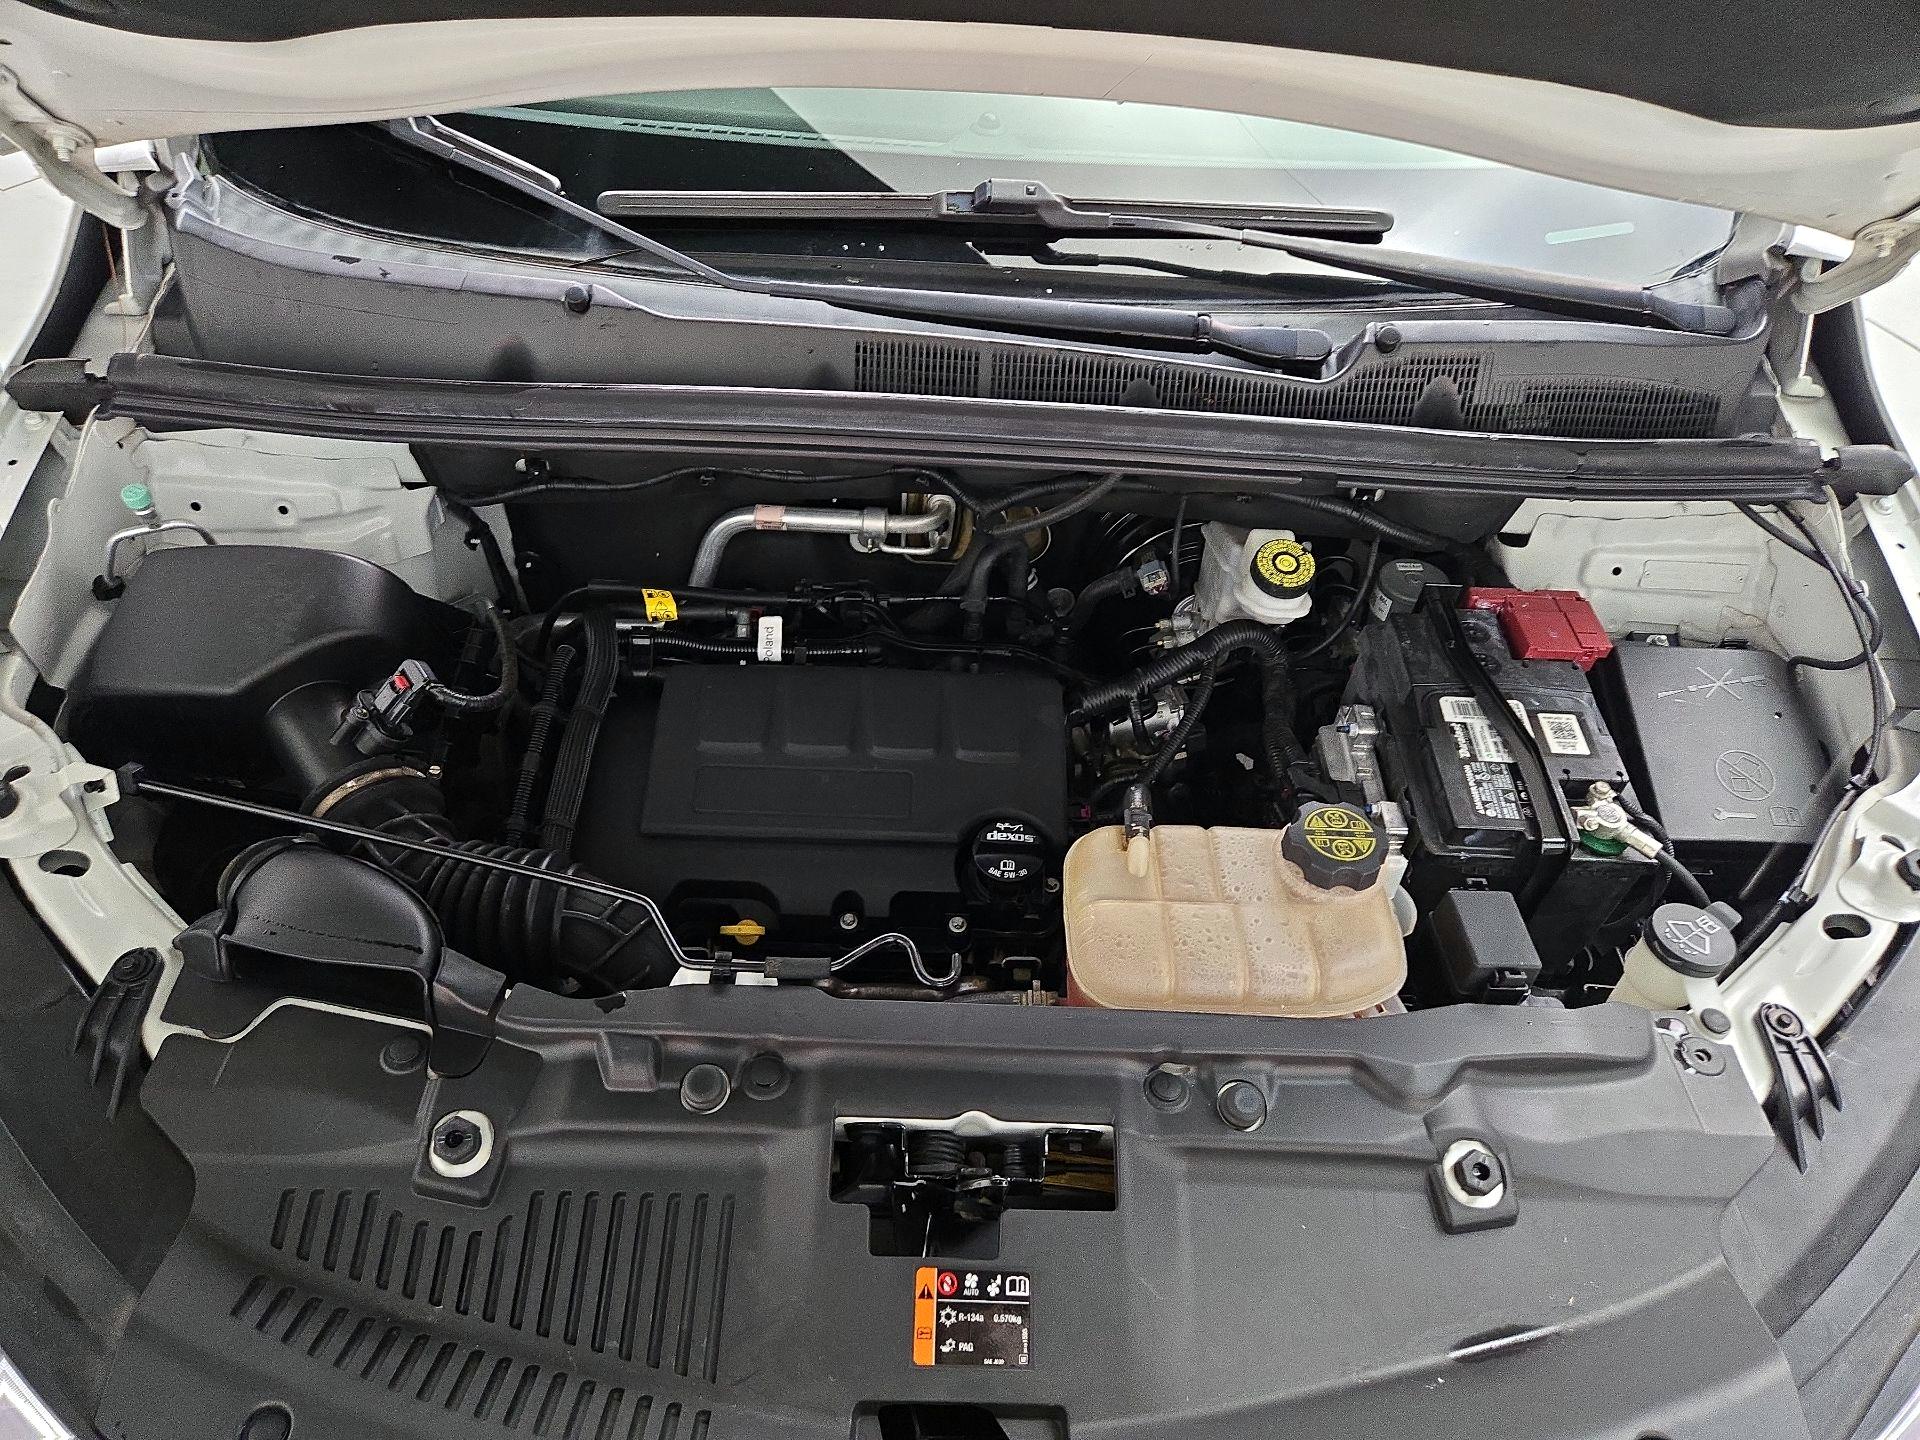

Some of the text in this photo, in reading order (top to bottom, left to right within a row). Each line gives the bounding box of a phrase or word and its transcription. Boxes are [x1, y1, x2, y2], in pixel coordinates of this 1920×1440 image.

[986, 830, 1034, 843] dexos
[987, 866, 1028, 879] SAE 5W-30
[963, 1288, 979, 1296] AUTO
[959, 1312, 984, 1322] R-134a
